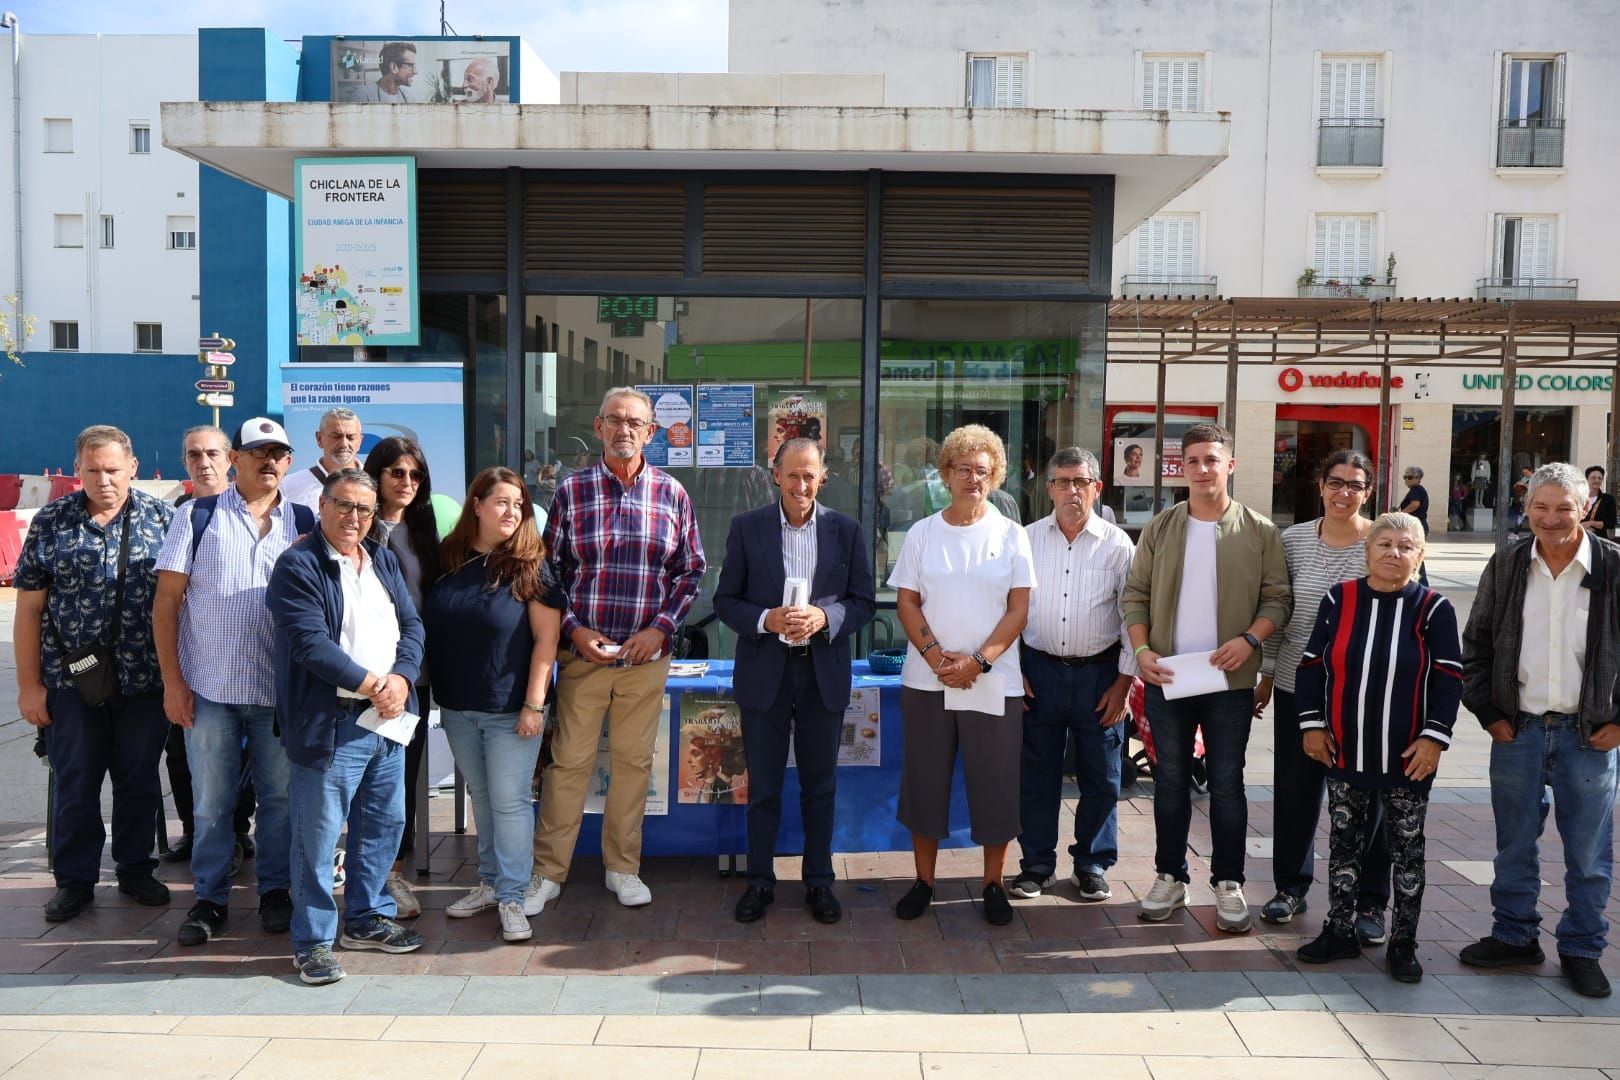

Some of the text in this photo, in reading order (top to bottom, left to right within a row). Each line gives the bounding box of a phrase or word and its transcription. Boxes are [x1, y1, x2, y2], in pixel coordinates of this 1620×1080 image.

[309, 179, 401, 190] CHICLANA DE LA
[325, 192, 385, 202] FRONTERA
[307, 218, 331, 226] CIUDAD
[332, 218, 354, 226] AMIGA
[1309, 371, 1404, 388] vodafoe
[1537, 375, 1613, 391] COLORS
[290, 382, 391, 391] El corazón tiene razones
[290, 394, 371, 404] que la razón ignora
[68, 654, 99, 675] PUMA
